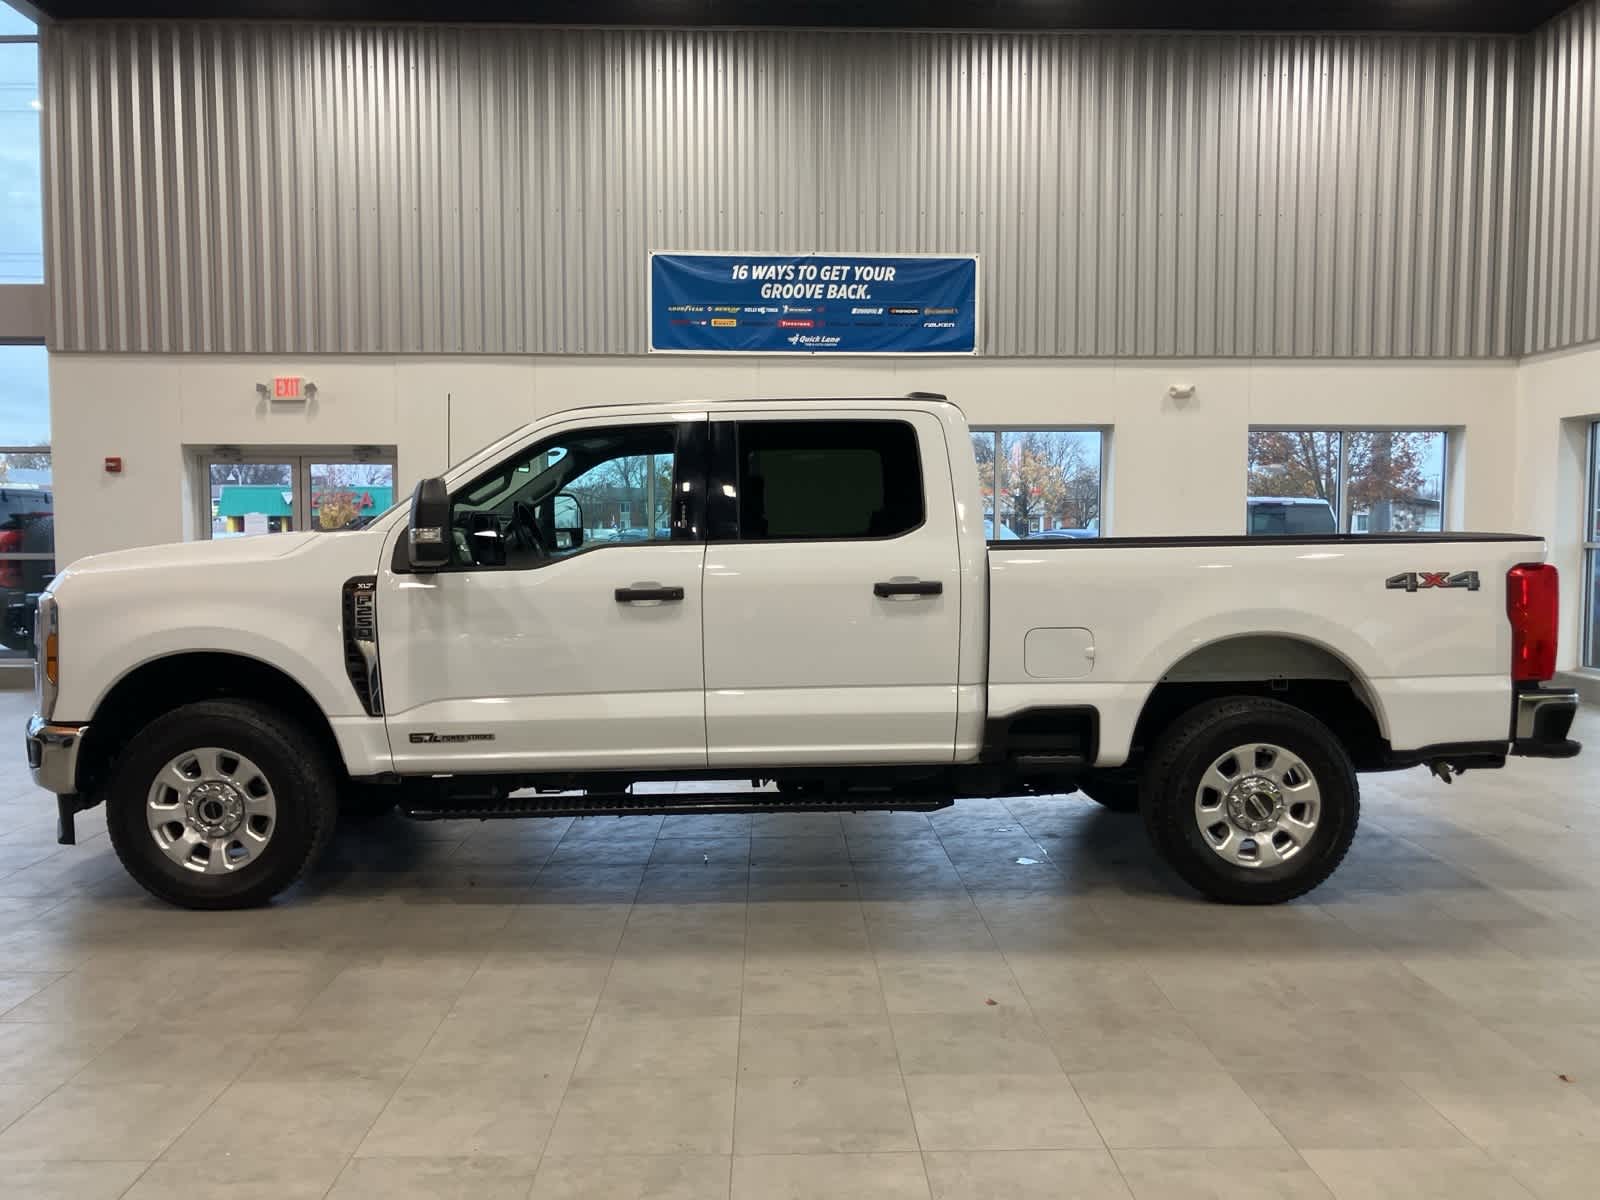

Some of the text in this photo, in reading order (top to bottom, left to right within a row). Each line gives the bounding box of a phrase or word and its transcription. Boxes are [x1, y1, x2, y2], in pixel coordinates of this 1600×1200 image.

[731, 265, 897, 282] 16 WAYS TO GET YOUR
[760, 283, 872, 300] GROOVE BACK.
[799, 335, 841, 343] Quick Lane
[274, 377, 300, 398] EXIT
